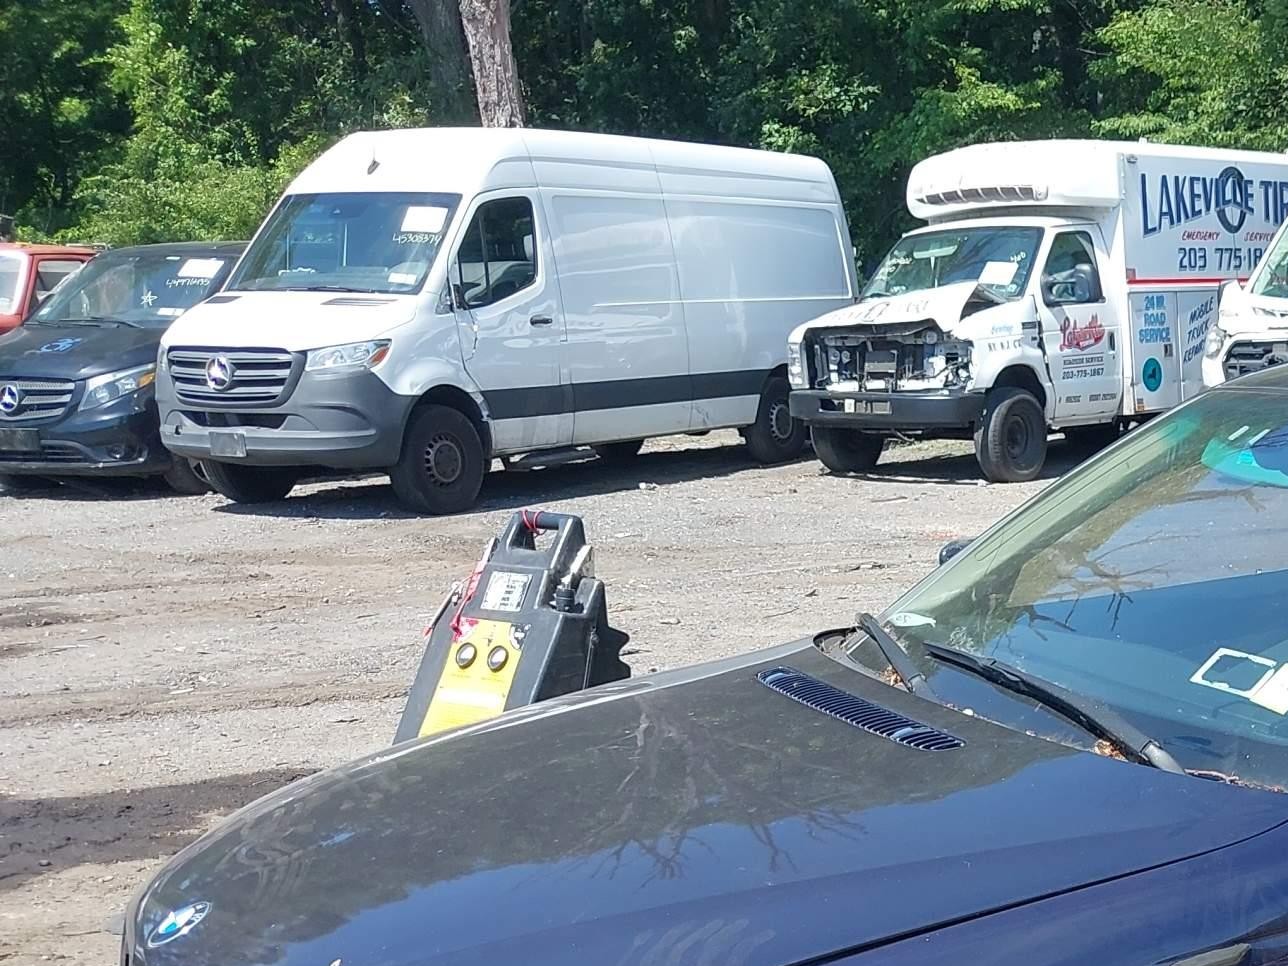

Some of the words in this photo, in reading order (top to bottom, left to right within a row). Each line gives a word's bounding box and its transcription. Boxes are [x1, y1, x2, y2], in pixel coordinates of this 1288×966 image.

[1140, 172, 1254, 238] LAKEVILLE
[1181, 230, 1220, 241] EMERGENCY
[1178, 247, 1207, 272] 203
[1143, 312, 1166, 327] ROAD
[1188, 296, 1214, 323] MOBILE
[1138, 327, 1171, 344] SERVICE
[1186, 319, 1211, 344] TRUCK
